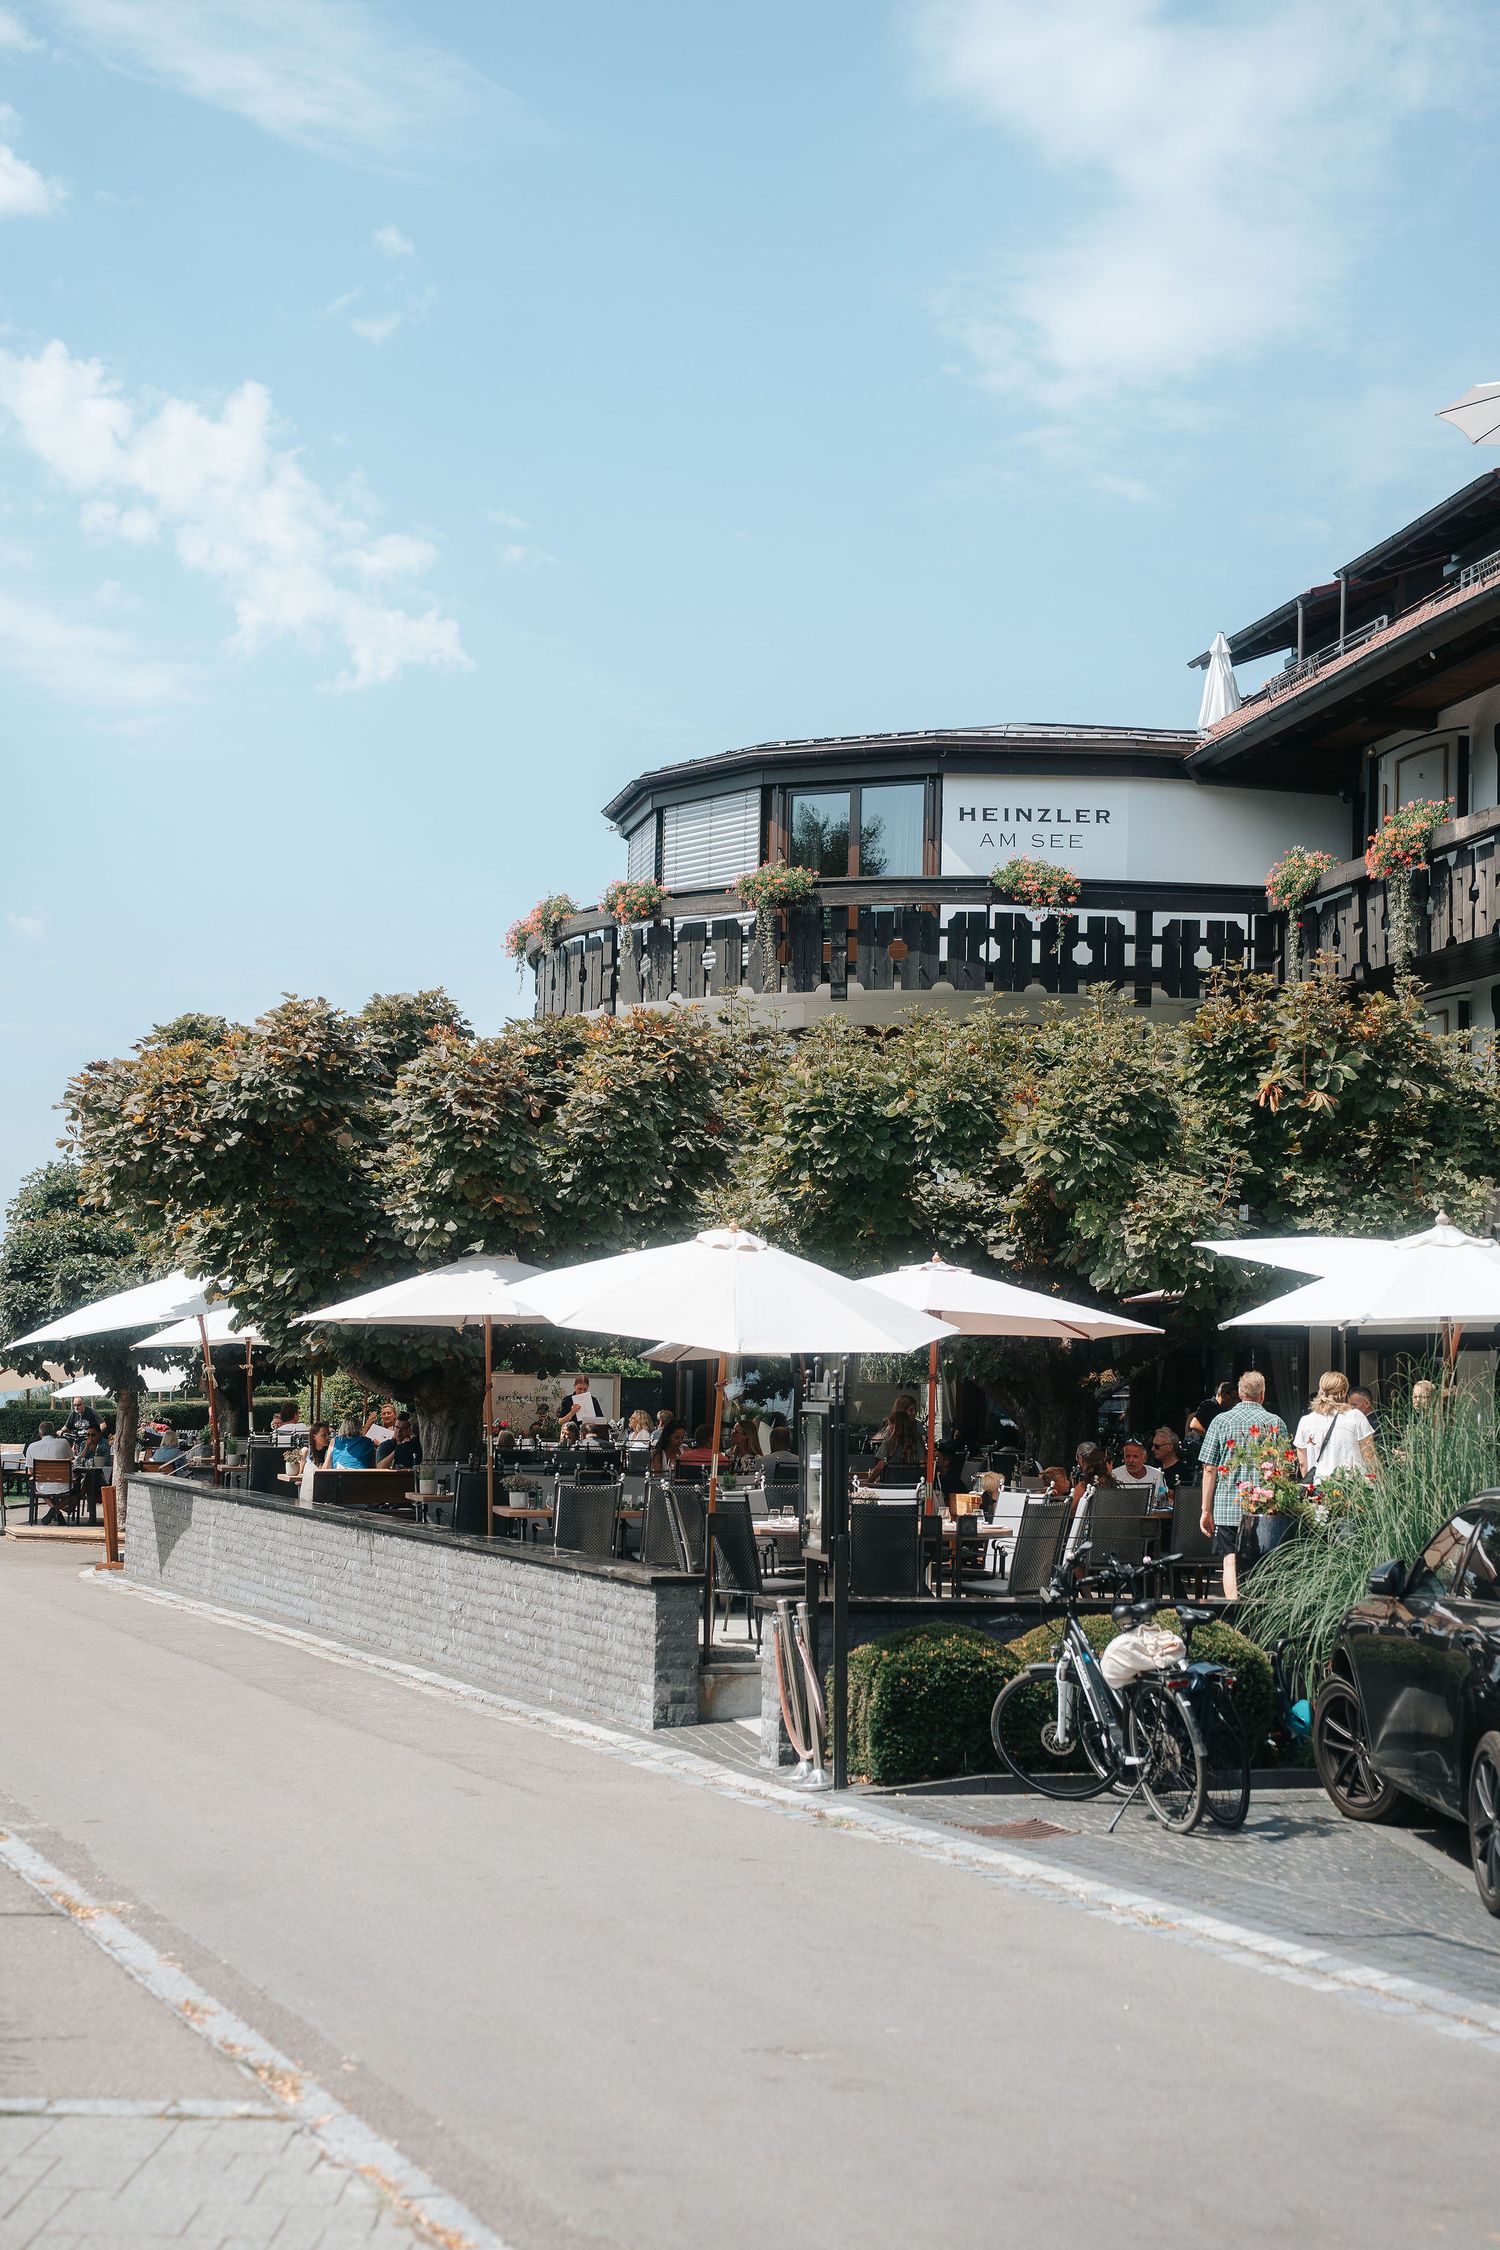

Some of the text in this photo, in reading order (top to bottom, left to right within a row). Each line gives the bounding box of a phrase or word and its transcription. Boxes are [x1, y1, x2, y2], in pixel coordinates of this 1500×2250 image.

[959, 807, 1111, 824] HEINZLER
[979, 833, 1083, 849] AM SEE
